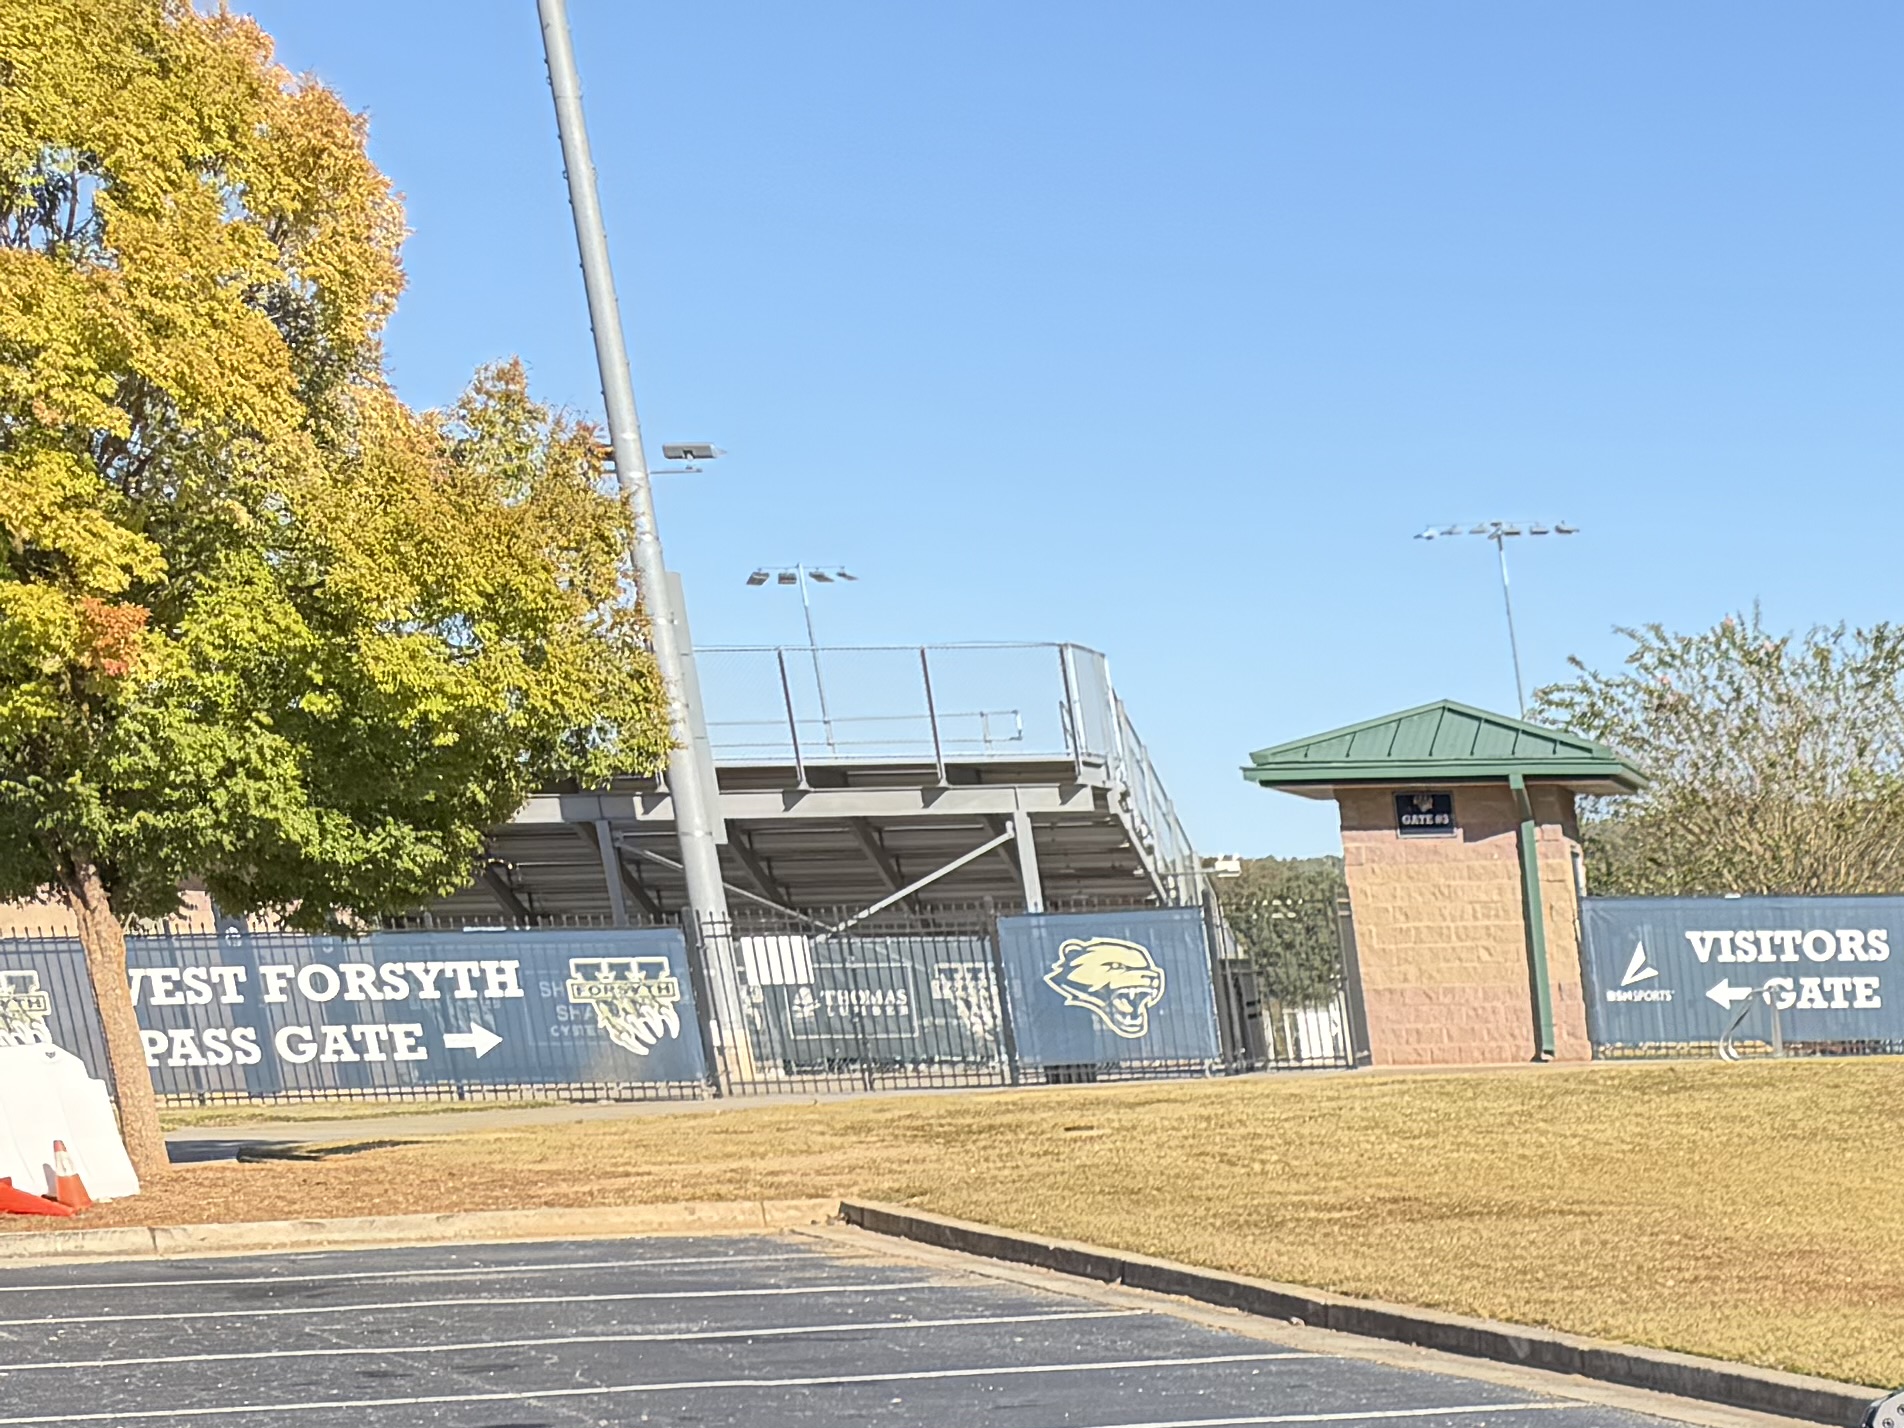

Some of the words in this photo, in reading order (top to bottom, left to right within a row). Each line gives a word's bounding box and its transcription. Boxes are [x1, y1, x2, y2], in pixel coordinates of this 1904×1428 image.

[1401, 814, 1434, 825] GATE
[1685, 929, 1890, 963] VISITORS
[262, 959, 524, 1002] FORSYTH
[1762, 976, 1881, 1010] GATE
[142, 1027, 262, 1067] PASS
[275, 1022, 429, 1064] GATE
